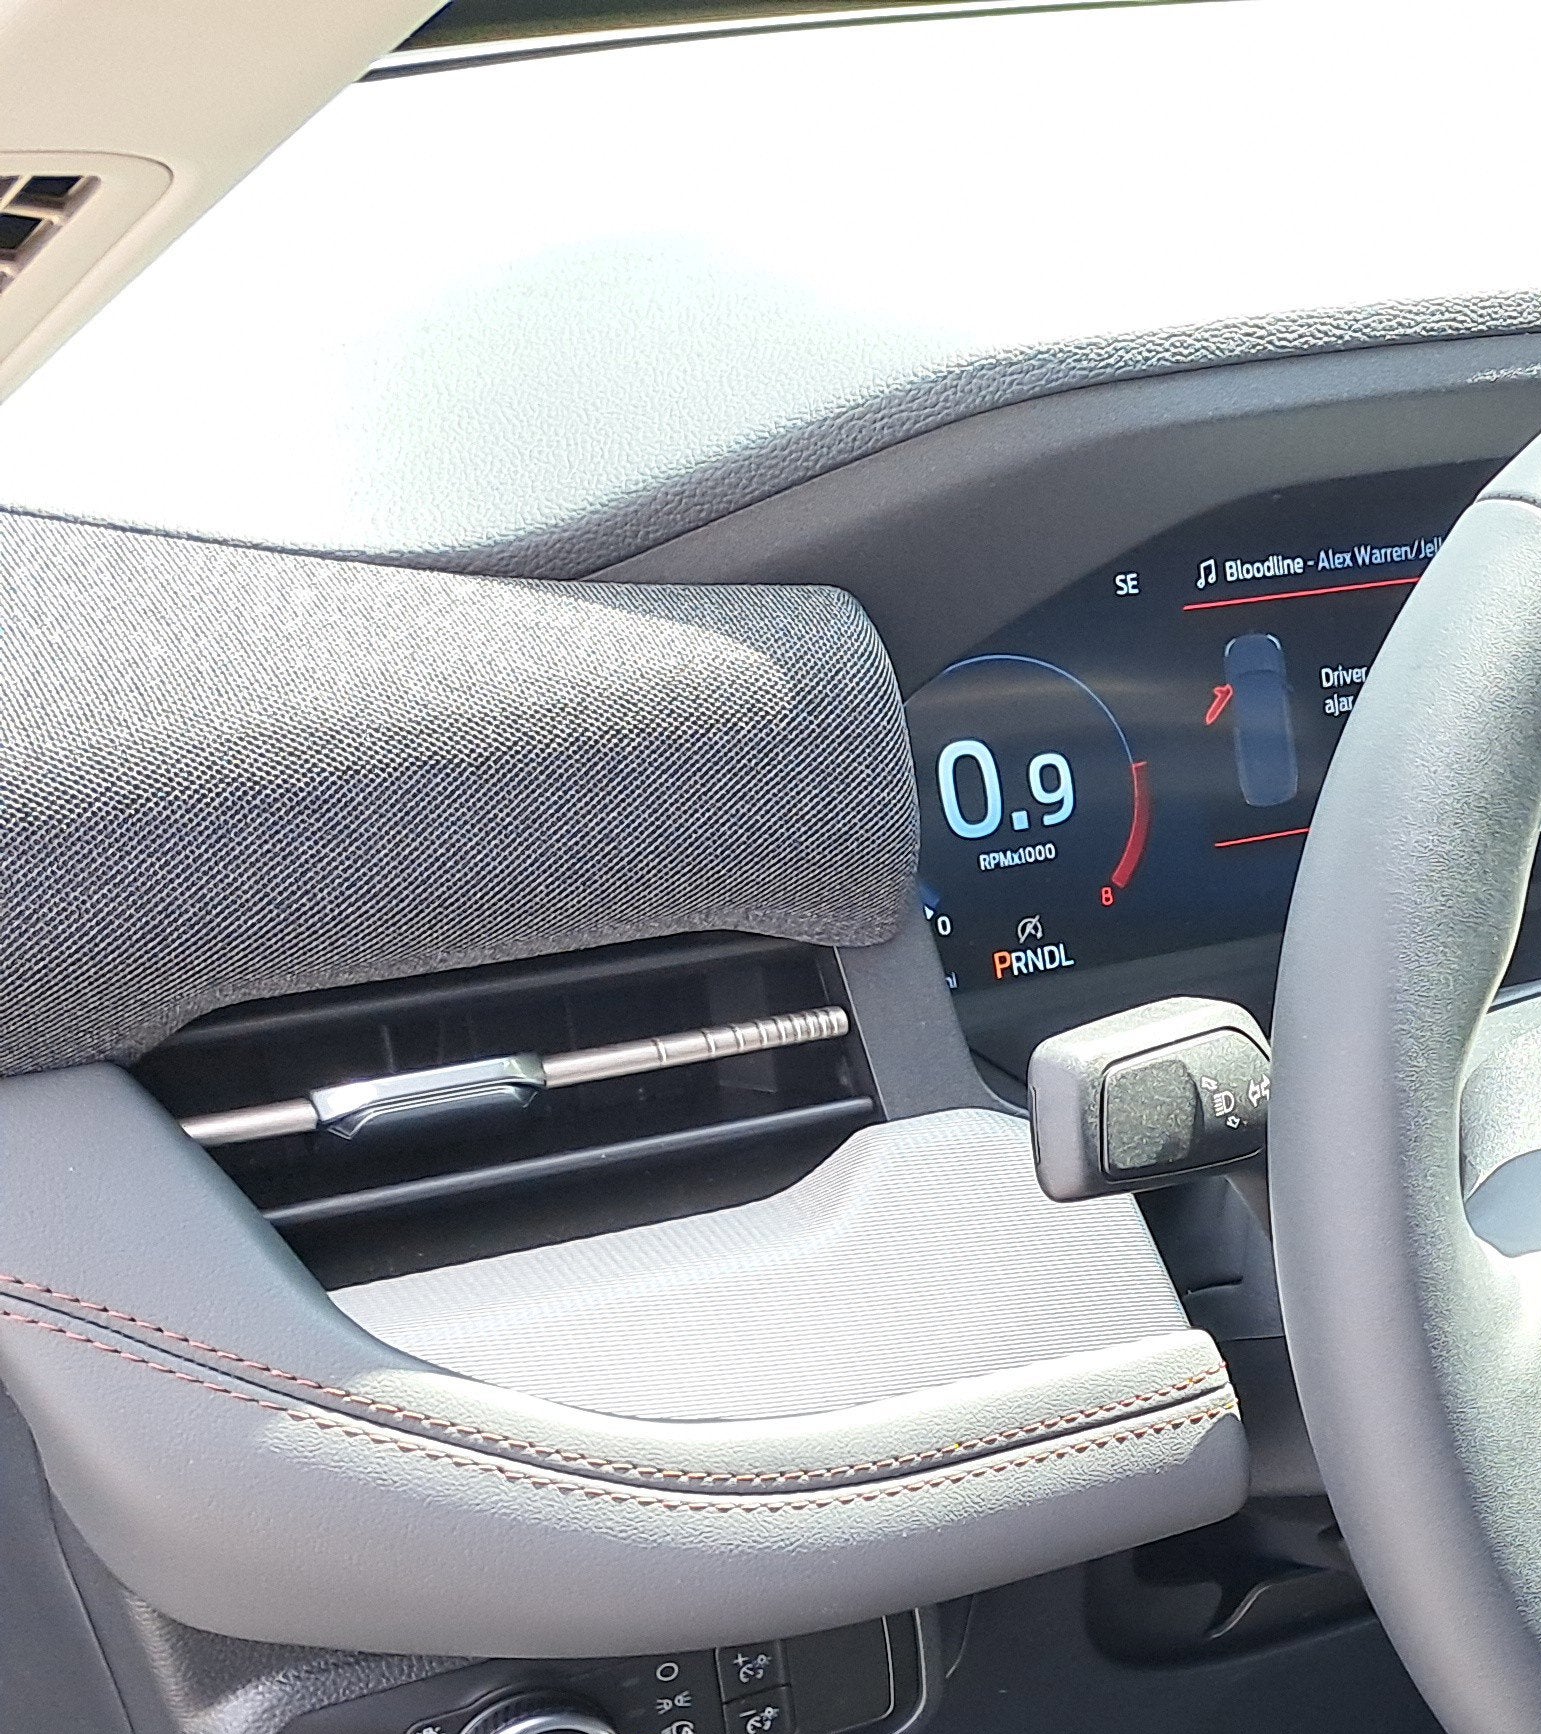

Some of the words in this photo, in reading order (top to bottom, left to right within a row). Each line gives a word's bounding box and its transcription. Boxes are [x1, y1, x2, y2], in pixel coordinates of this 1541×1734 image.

[1225, 555, 1304, 582] Bloodline
[1318, 550, 1353, 572] Alex
[1115, 572, 1139, 595] SE
[1321, 664, 1368, 688] Driver
[1324, 693, 1354, 717] ajar
[937, 739, 1077, 840] 0.9
[979, 843, 1057, 872] RPMx1000
[1101, 886, 1114, 907] 8
[937, 915, 952, 936] 0
